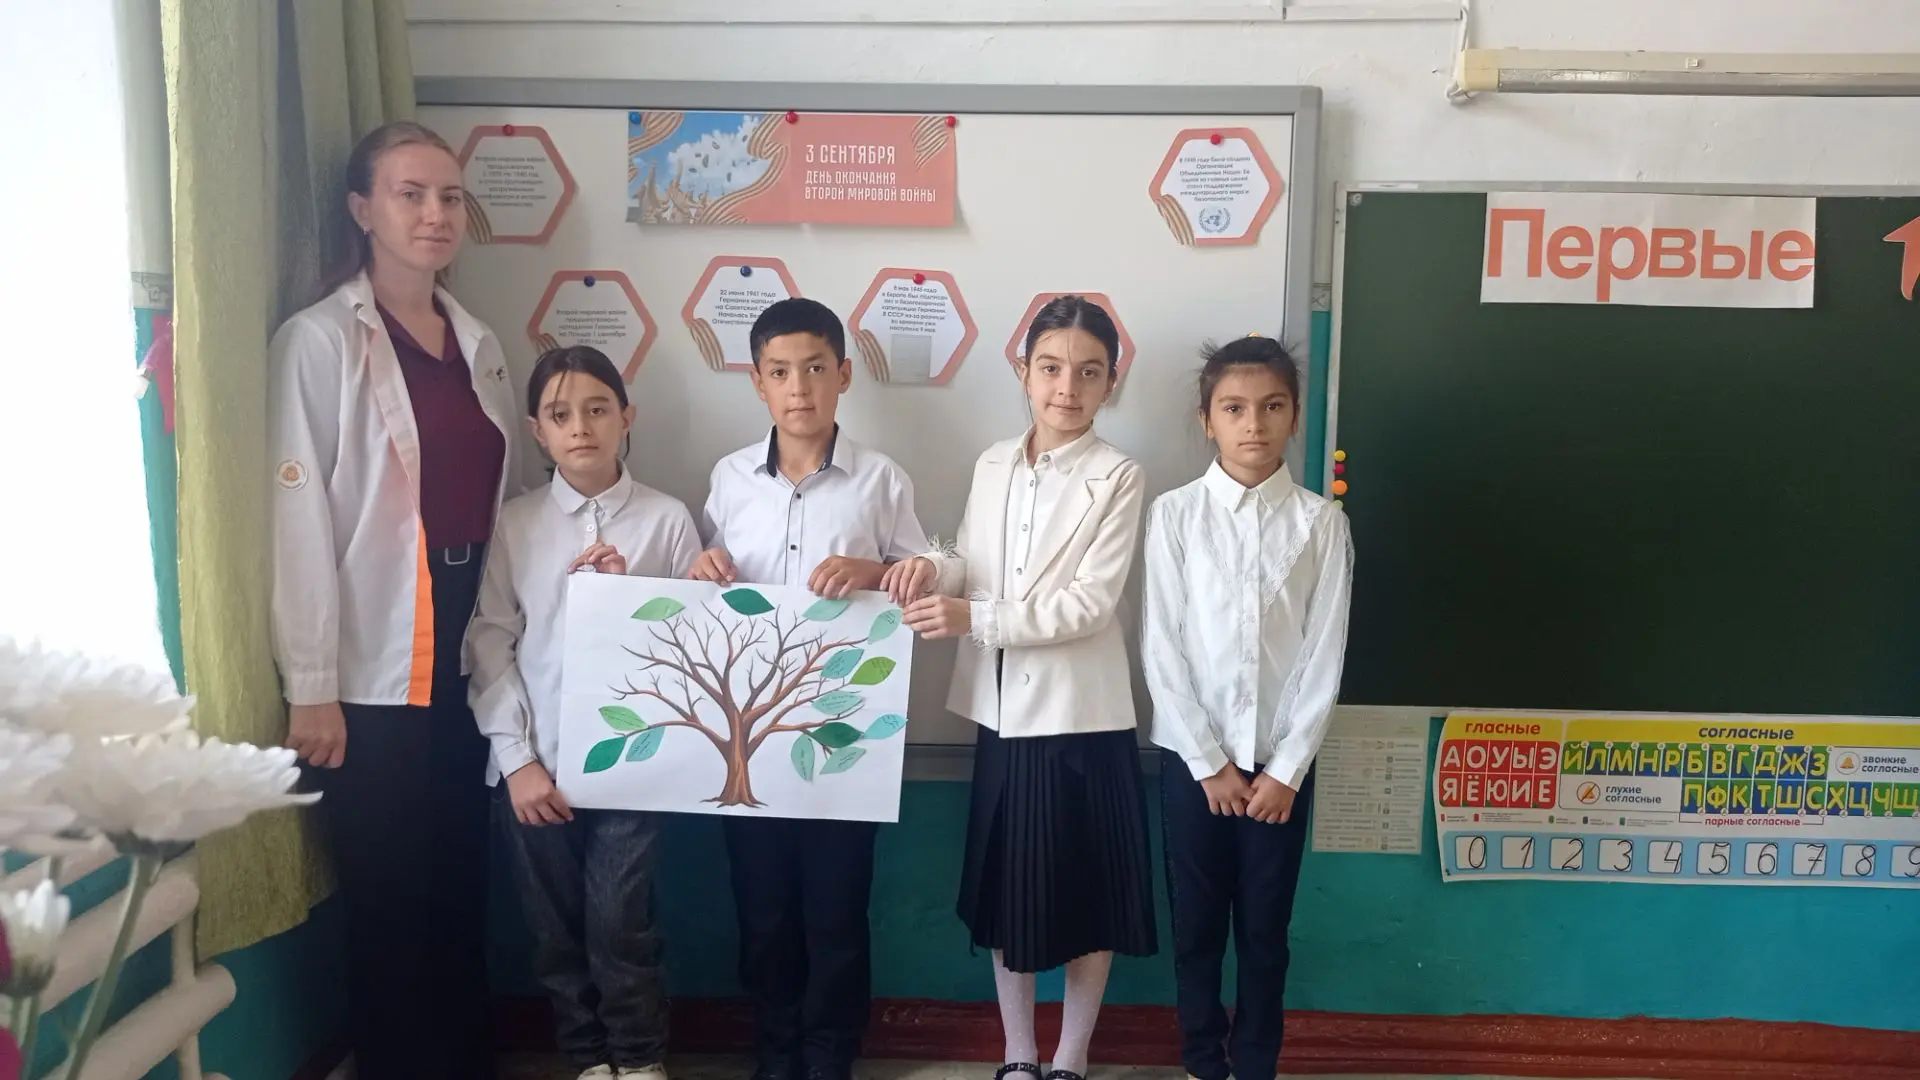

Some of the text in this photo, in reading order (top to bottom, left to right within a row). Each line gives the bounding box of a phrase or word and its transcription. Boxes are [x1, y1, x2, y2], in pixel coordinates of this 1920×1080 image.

[806, 144, 896, 165] 3 СЕНТЯБРЯ
[805, 170, 896, 185] ДЕНЬ ОКОНЧАНИЯ
[805, 185, 936, 202] ВТОРОЙ МИРОВОЙ ВОЙНЫ
[1487, 208, 1815, 302] Первые
[1465, 722, 1541, 735] гласные
[1699, 726, 1794, 740] согласные
[1863, 756, 1907, 764] звонкие
[1862, 764, 1919, 774] согласные
[1606, 786, 1642, 796] глухие
[1606, 795, 1662, 804] согласные
[1705, 818, 1800, 827] парные согласные
[1468, 837, 1486, 868] 0
[1521, 837, 1533, 869] 1
[1562, 838, 1584, 870] 2
[1613, 840, 1633, 871] 3
[1664, 841, 1681, 873] 4
[1708, 843, 1729, 873] 5
[1757, 844, 1778, 874] 6
[1807, 844, 1826, 875] 7
[1855, 845, 1876, 876] 8
